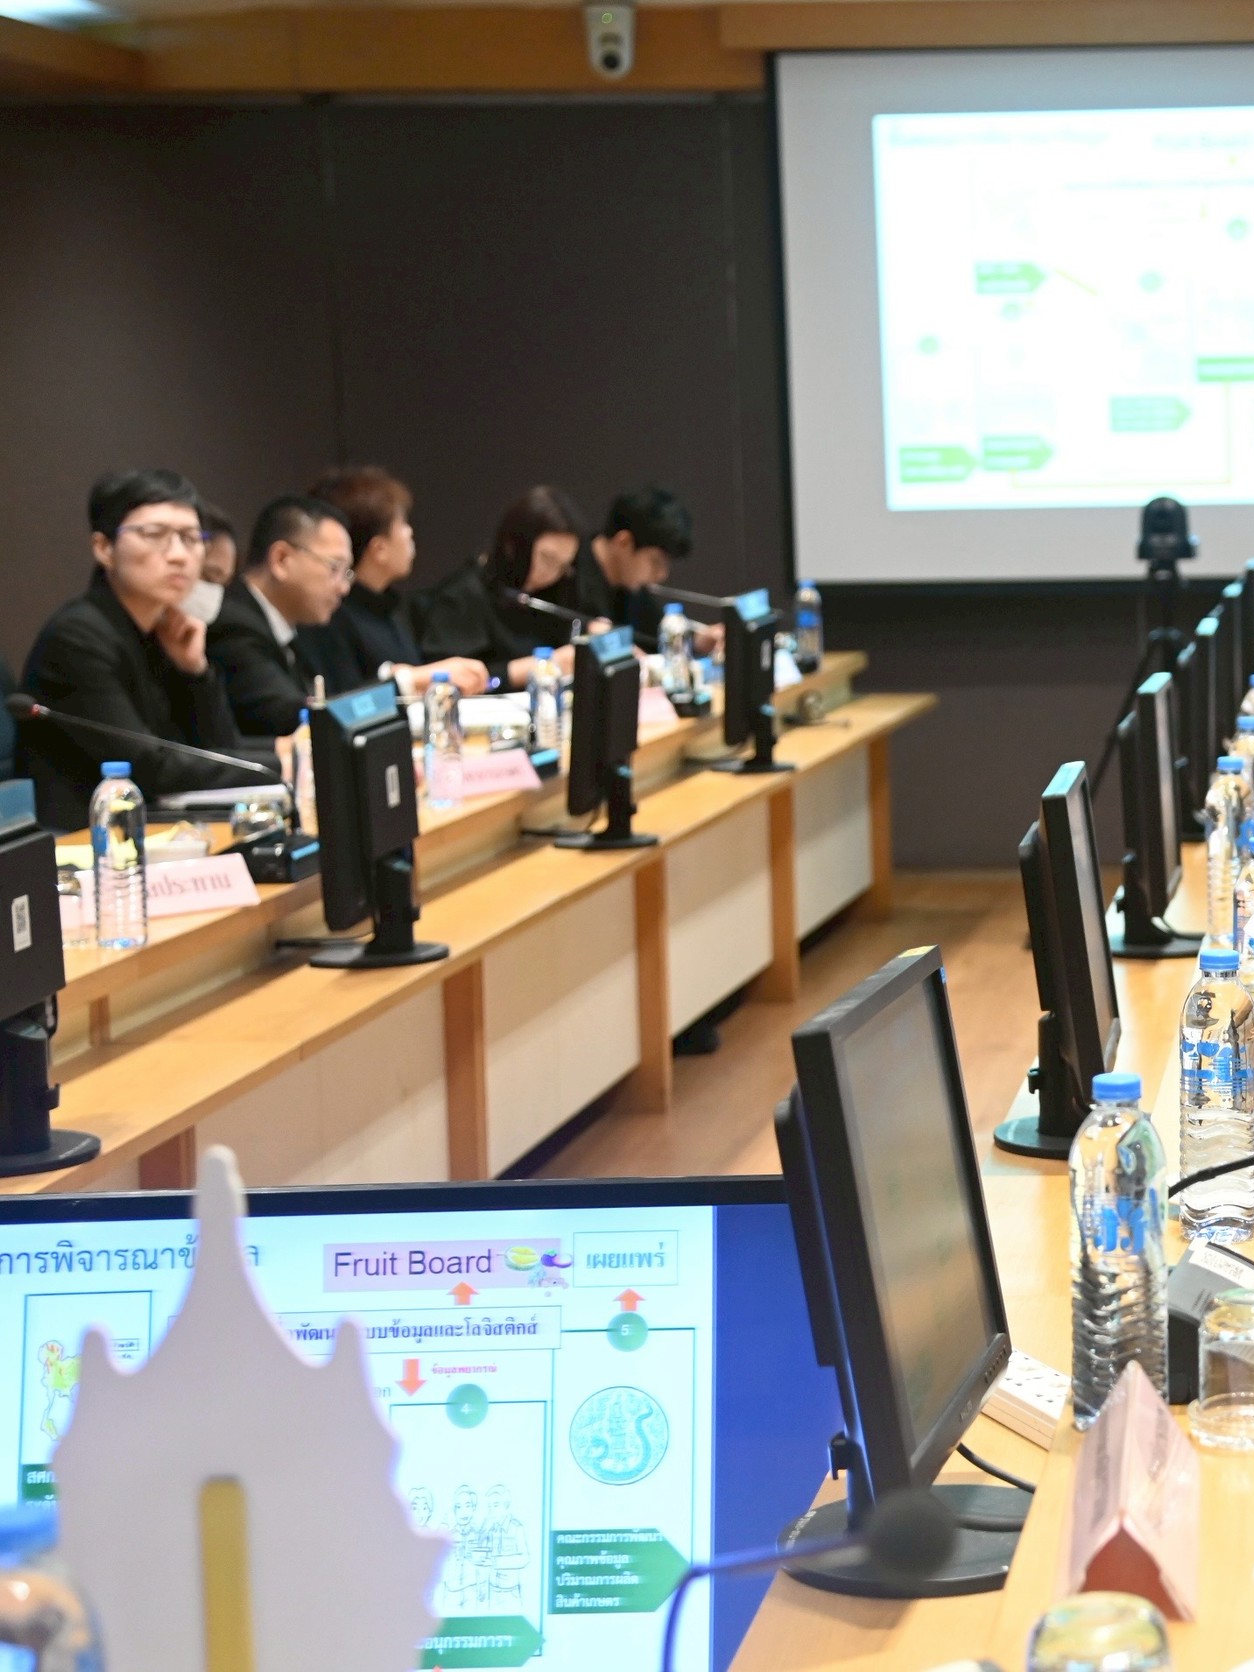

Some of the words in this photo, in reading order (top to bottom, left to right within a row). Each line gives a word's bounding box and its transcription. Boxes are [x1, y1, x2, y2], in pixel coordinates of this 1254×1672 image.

[334, 1251, 397, 1277] Fruit
[408, 1249, 492, 1276] Board
[586, 1241, 665, 1269] เผยแพร่
[620, 1324, 630, 1336] 5
[460, 1403, 472, 1415] 4
[556, 1550, 630, 1569] คุณภาพข้อมูล
[556, 1571, 640, 1586] ปริมาณการผลิต
